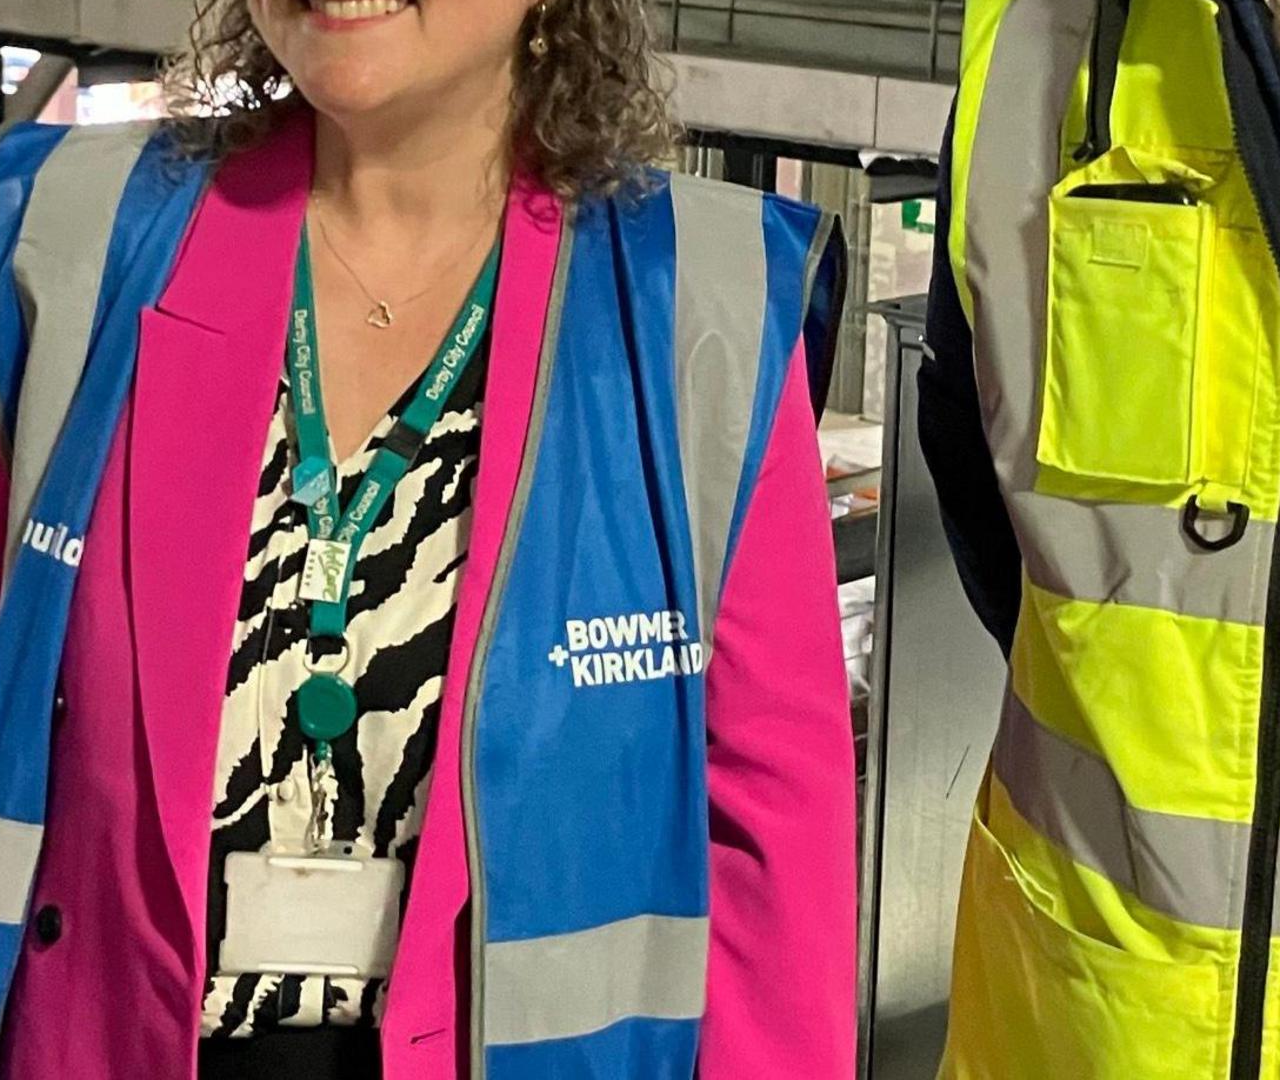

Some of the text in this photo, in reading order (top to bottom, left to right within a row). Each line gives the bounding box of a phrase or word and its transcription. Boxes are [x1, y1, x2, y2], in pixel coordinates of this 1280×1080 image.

[292, 308, 316, 415] Derby City Council
[425, 303, 486, 401] Derby City Council
[349, 480, 381, 521] Council
[565, 610, 689, 651] BOWMER
